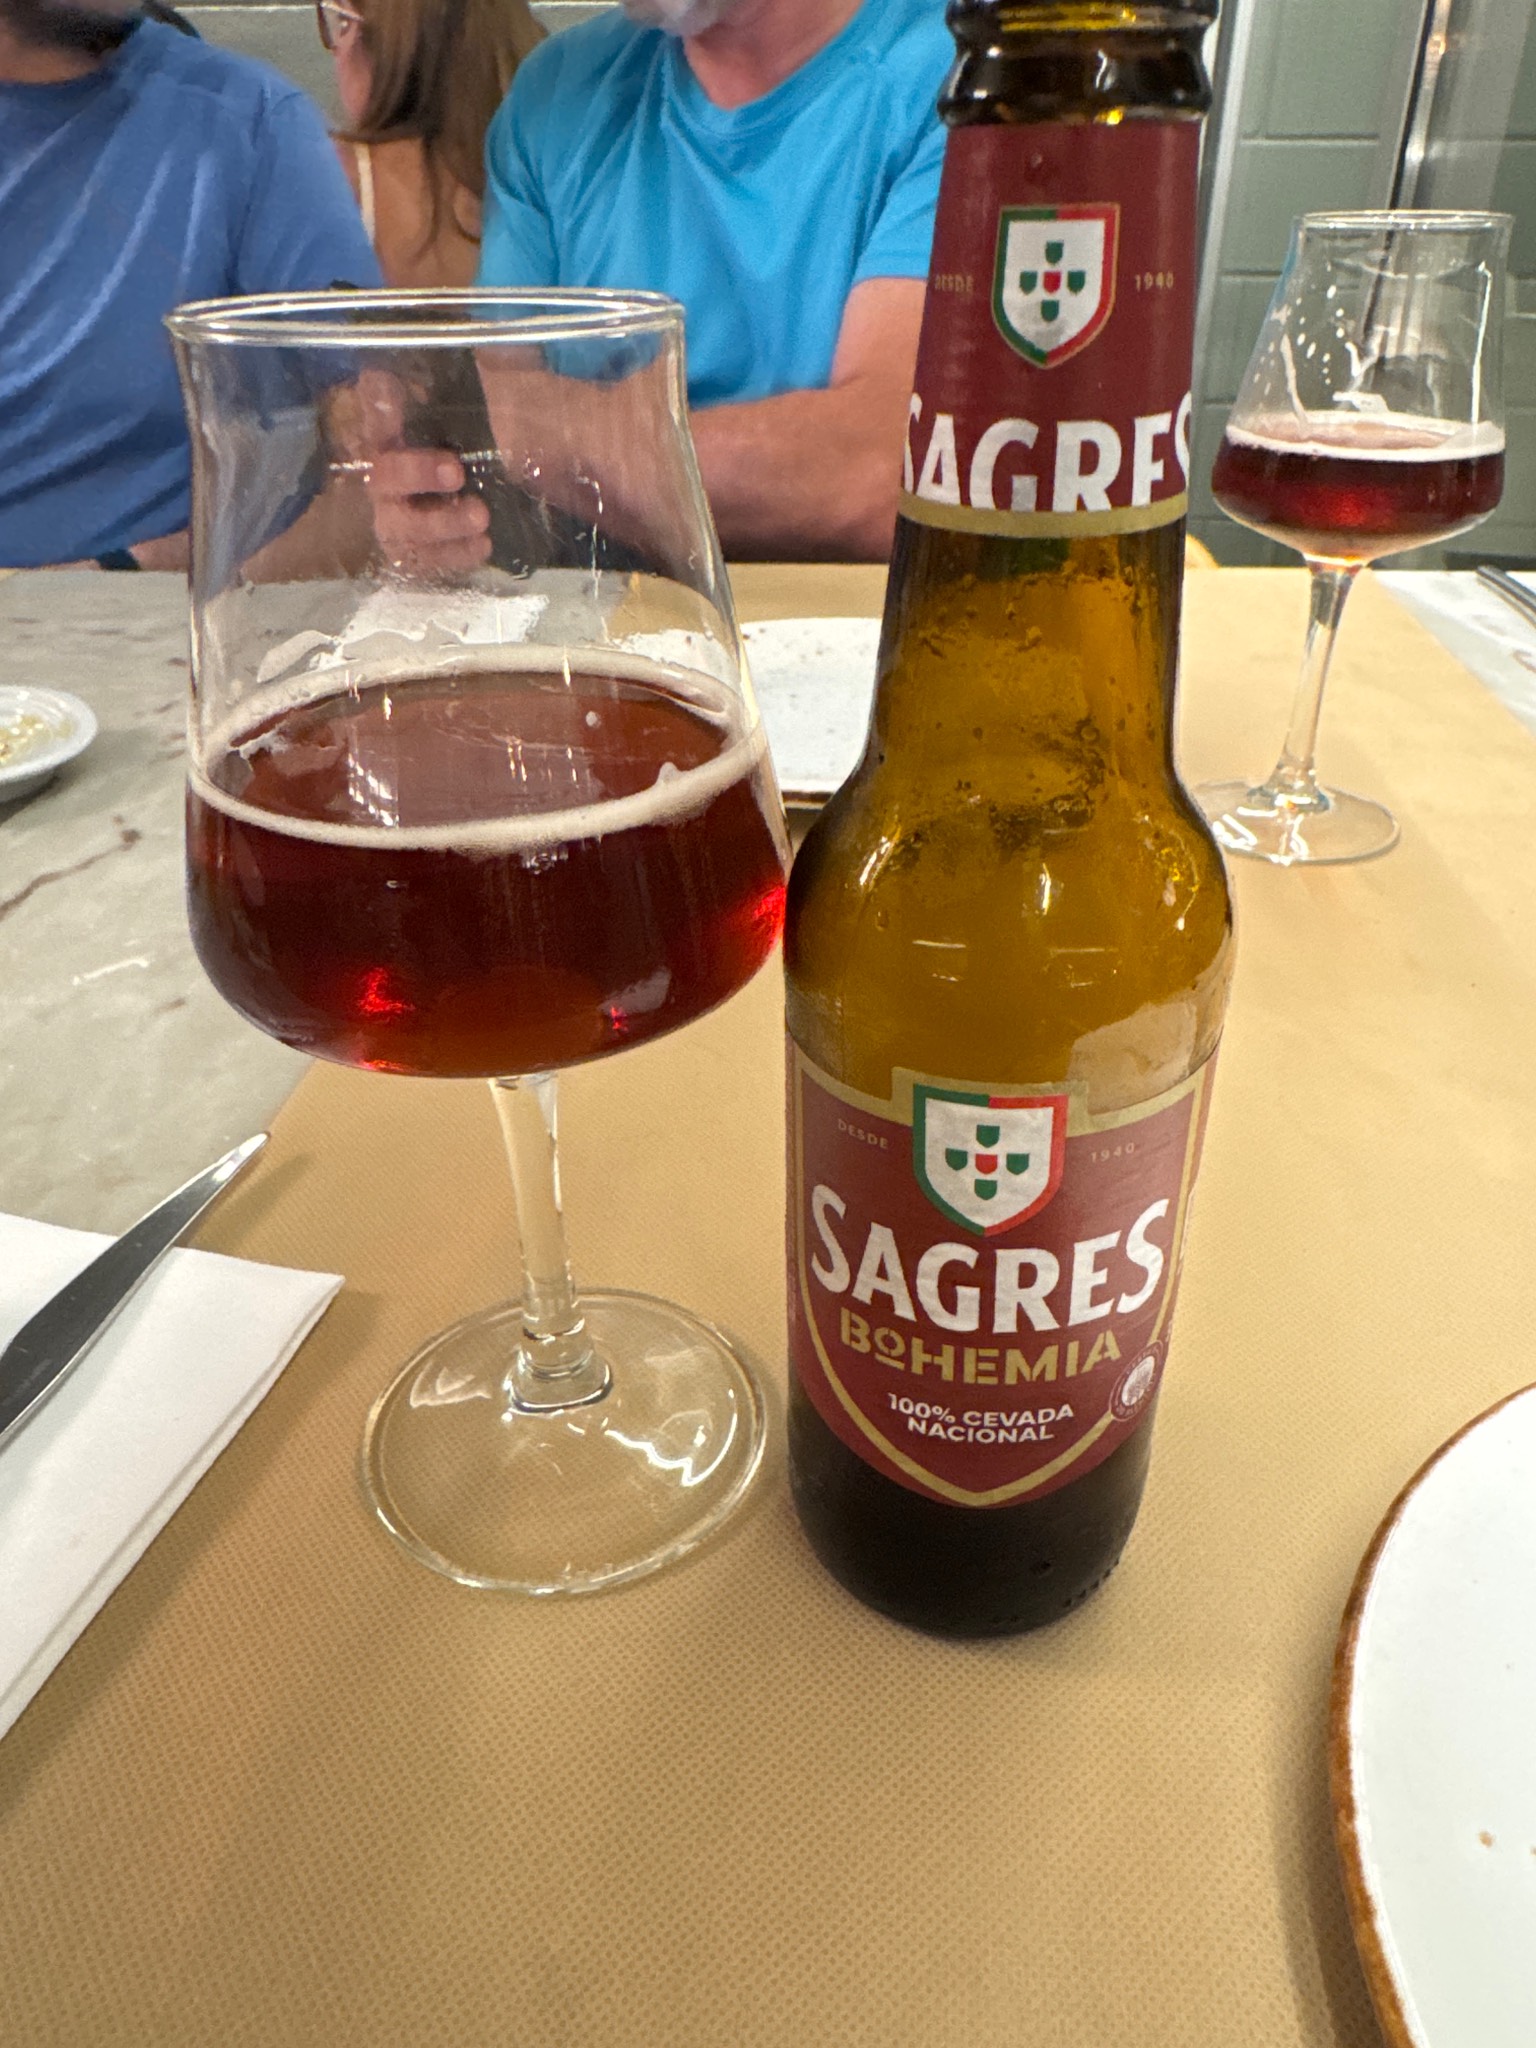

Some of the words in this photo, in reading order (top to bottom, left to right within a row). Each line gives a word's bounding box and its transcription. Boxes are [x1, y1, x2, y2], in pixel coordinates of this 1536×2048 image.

[1134, 272, 1174, 292] 1940
[837, 1118, 889, 1149] DESDE
[1090, 1142, 1135, 1164] 1940
[811, 1184, 1170, 1334] SAGRES
[888, 1392, 956, 1424] 100%
[962, 1403, 1074, 1427] CEVADA
[907, 1416, 1054, 1443] NACIONAL
